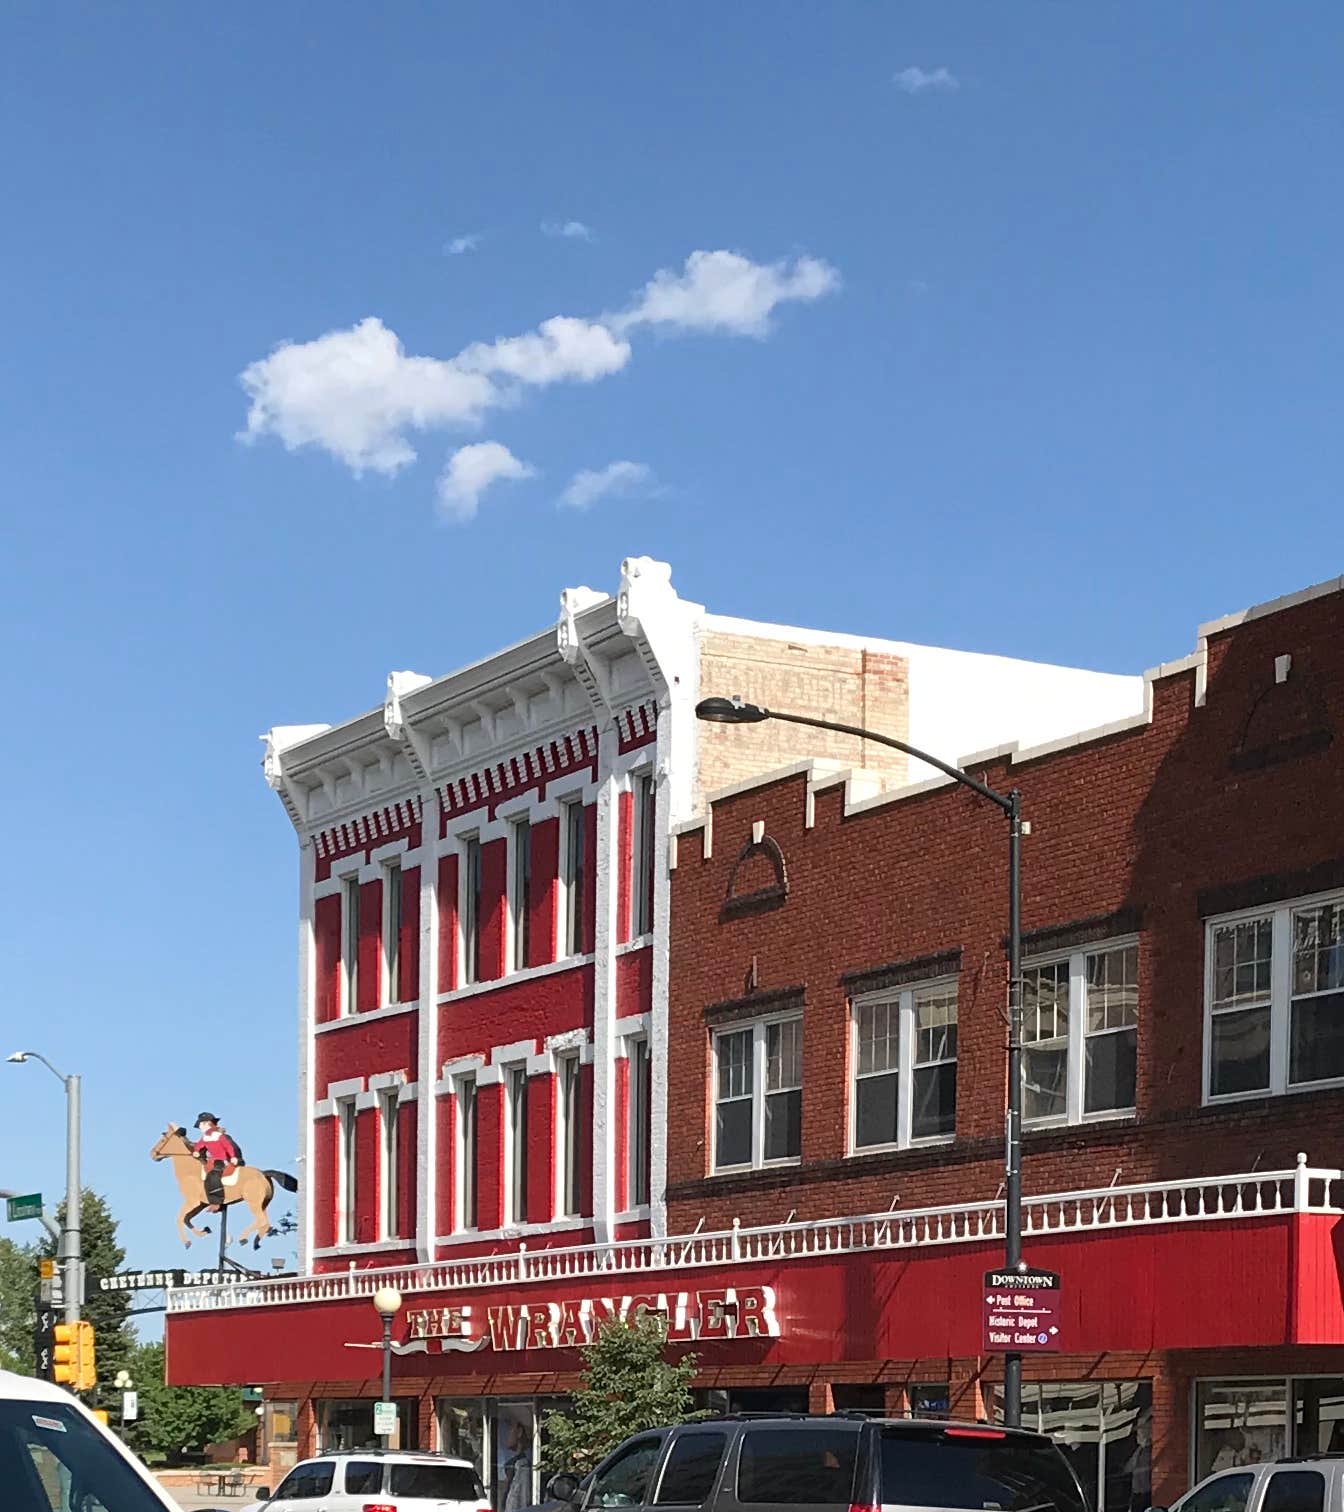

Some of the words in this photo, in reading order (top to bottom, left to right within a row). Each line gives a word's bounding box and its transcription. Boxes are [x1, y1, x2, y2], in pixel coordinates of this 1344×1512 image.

[100, 1273, 174, 1290] CHEYENNE
[991, 1274, 1053, 1287] DOWNTOWN
[997, 1294, 1012, 1306] Post
[1014, 1294, 1034, 1307] Office
[407, 1306, 472, 1338] THE
[989, 1315, 1016, 1327] Historic
[1018, 1316, 1038, 1329] Depot
[989, 1332, 1012, 1343] Visitor
[1014, 1332, 1037, 1344] Center
